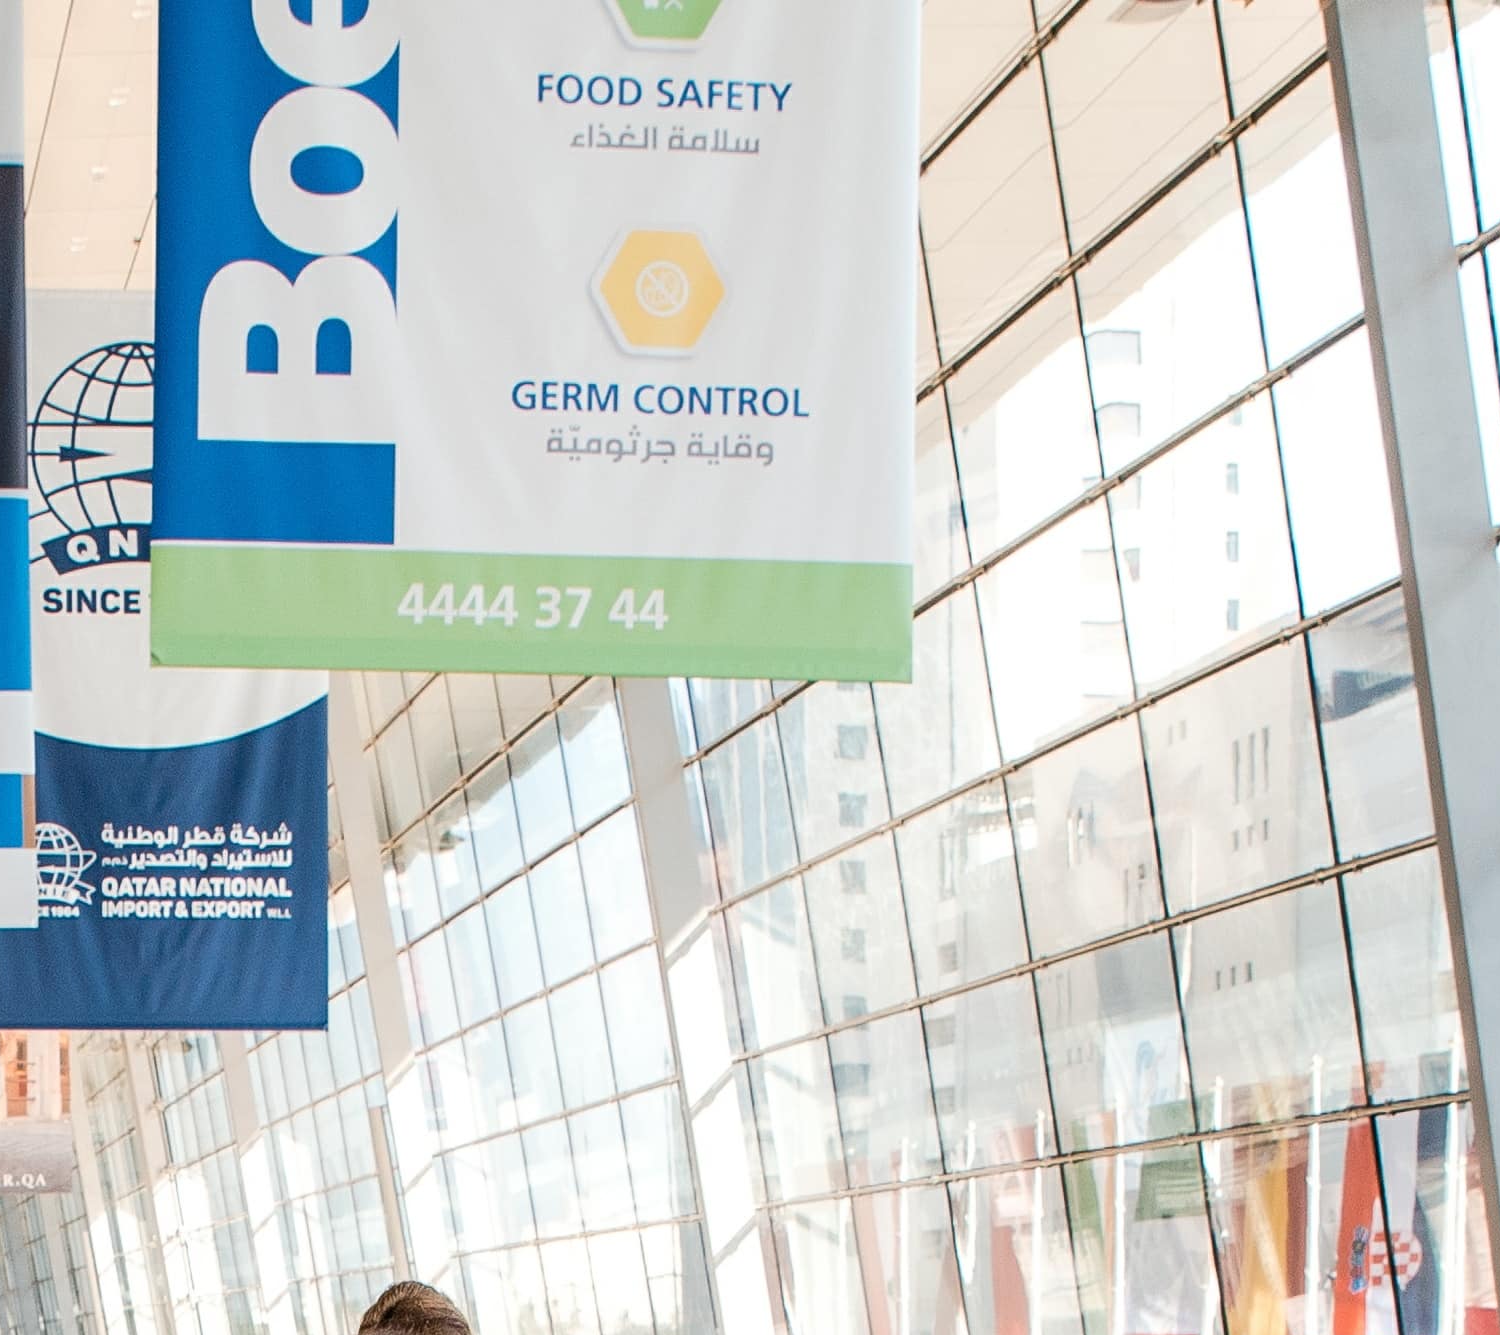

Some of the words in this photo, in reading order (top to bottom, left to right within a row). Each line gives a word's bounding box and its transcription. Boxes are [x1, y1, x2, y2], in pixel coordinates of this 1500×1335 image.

[537, 73, 643, 106] FOOD
[657, 78, 793, 112] SAFETY
[570, 123, 657, 151] الغذاء
[667, 126, 760, 154] سلامة
[511, 381, 619, 412] GERM
[633, 385, 810, 418] CONTROL
[687, 433, 775, 466] وقاية
[66, 530, 140, 563] QN
[43, 588, 141, 614] SINCE
[397, 582, 519, 628] 4444
[534, 586, 593, 630] 37
[608, 587, 669, 631] 44
[101, 822, 179, 849] الوطنية
[182, 825, 226, 849] قطر
[230, 822, 293, 849] شركة
[102, 876, 177, 899] QATAR
[179, 876, 293, 898] NATIONAL
[102, 900, 173, 919] IMPORT
[174, 900, 189, 918] &
[191, 900, 265, 919] EXPORT
